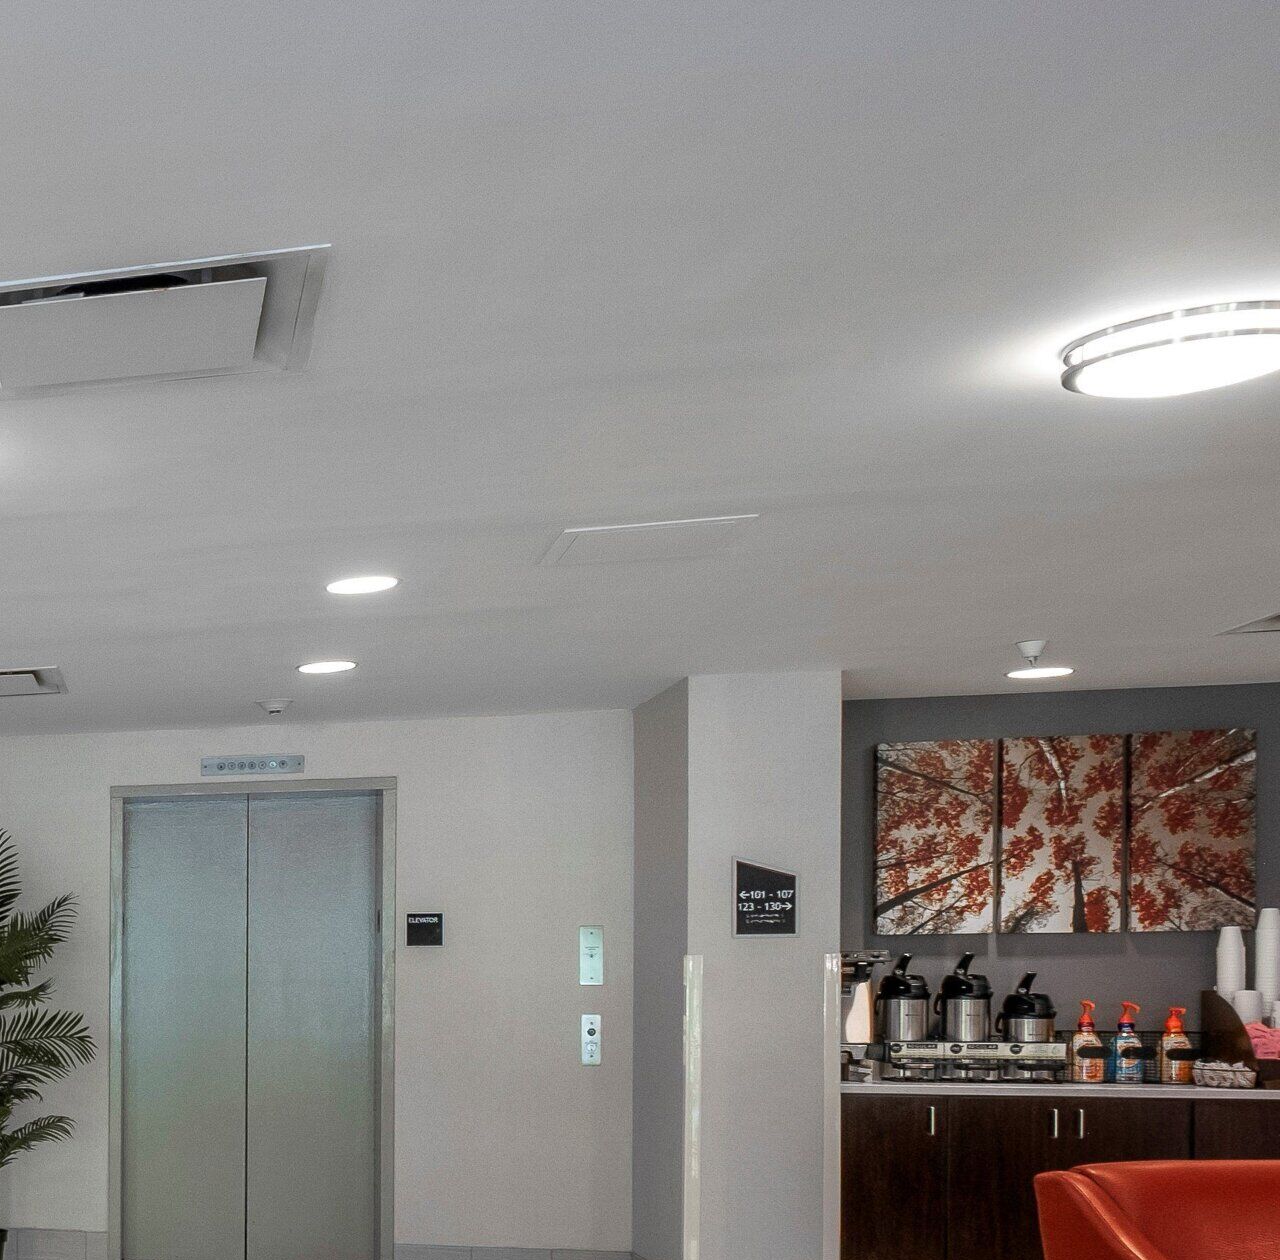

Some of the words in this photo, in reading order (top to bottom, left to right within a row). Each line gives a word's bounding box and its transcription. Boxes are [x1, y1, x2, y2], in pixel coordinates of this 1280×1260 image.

[750, 890, 766, 899] 101
[776, 889, 795, 899] 107
[738, 902, 755, 911] 123
[764, 902, 782, 911] 130
